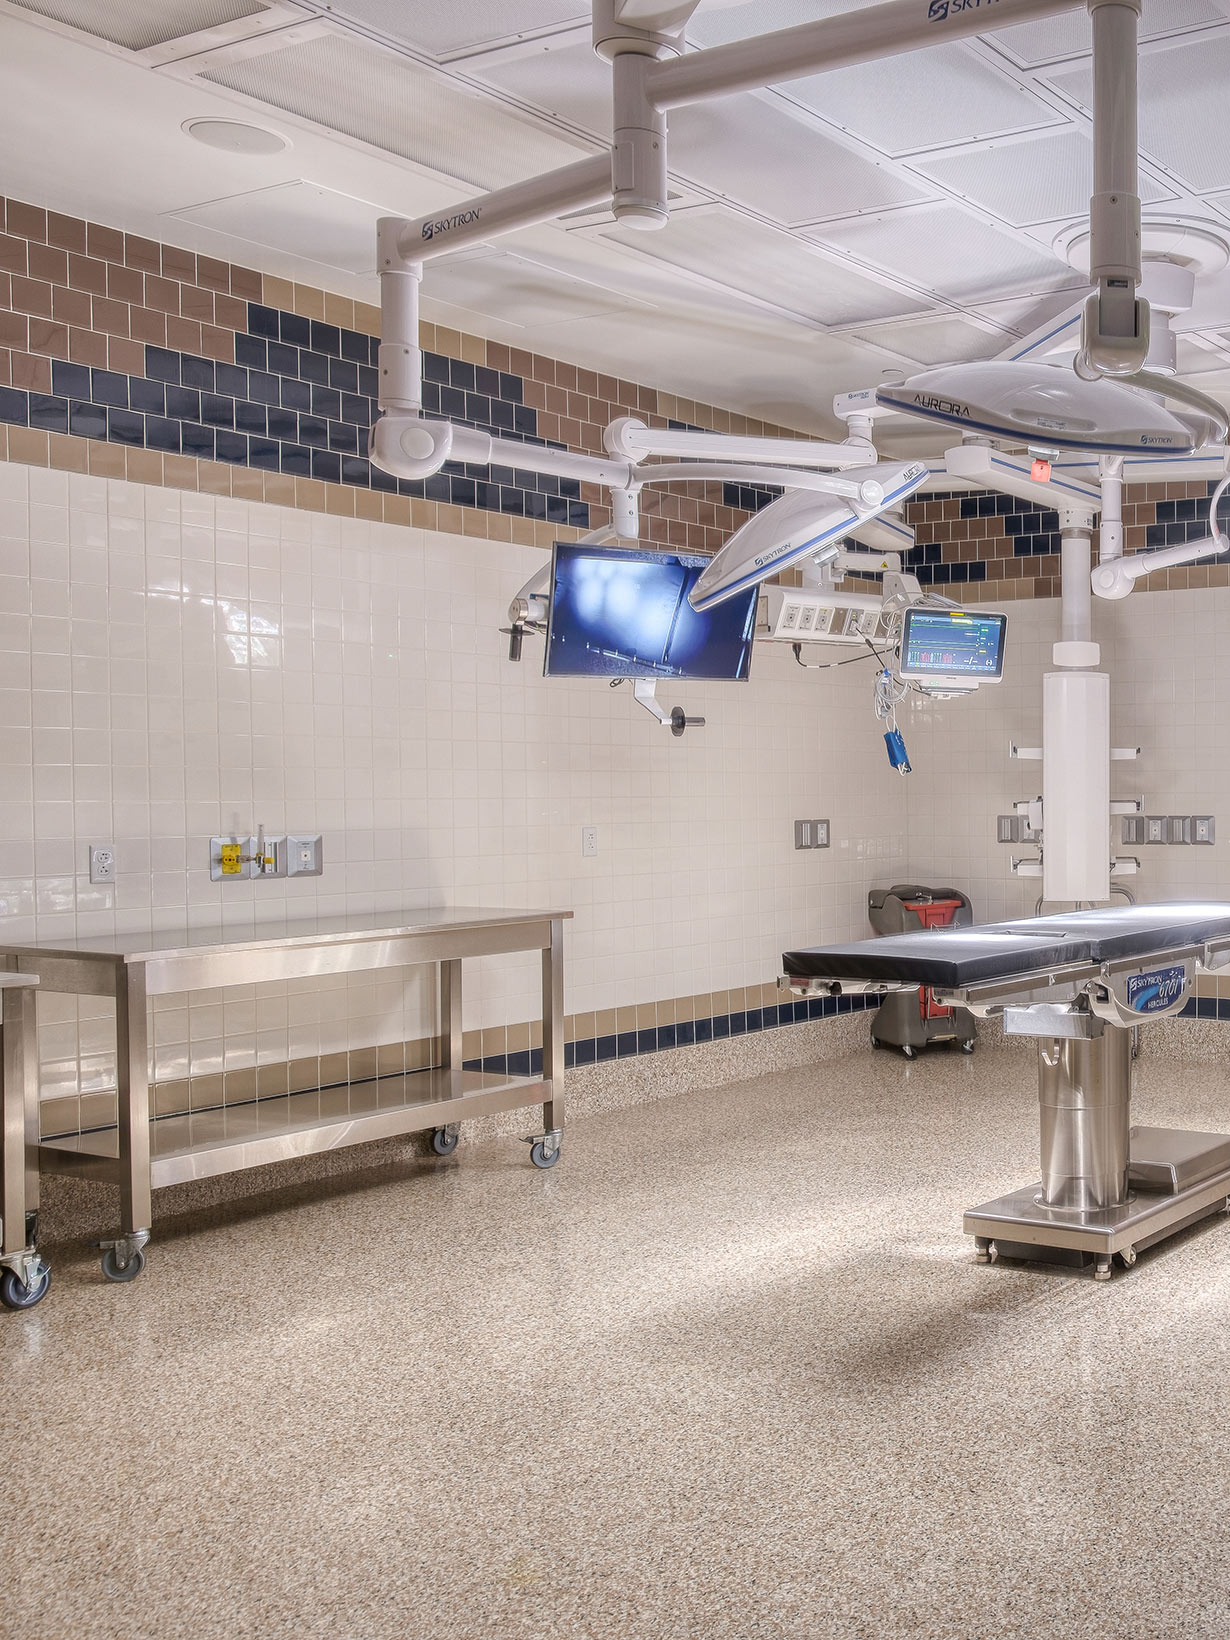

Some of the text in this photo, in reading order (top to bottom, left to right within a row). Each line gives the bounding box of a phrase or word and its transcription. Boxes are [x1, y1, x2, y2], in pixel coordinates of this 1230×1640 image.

[434, 208, 480, 234] SKYTRON
[914, 394, 973, 418] AURORA
[762, 542, 792, 562] SKYTRON
[1137, 975, 1162, 989] SKYTRON
[1147, 997, 1169, 1009] HERCULES
